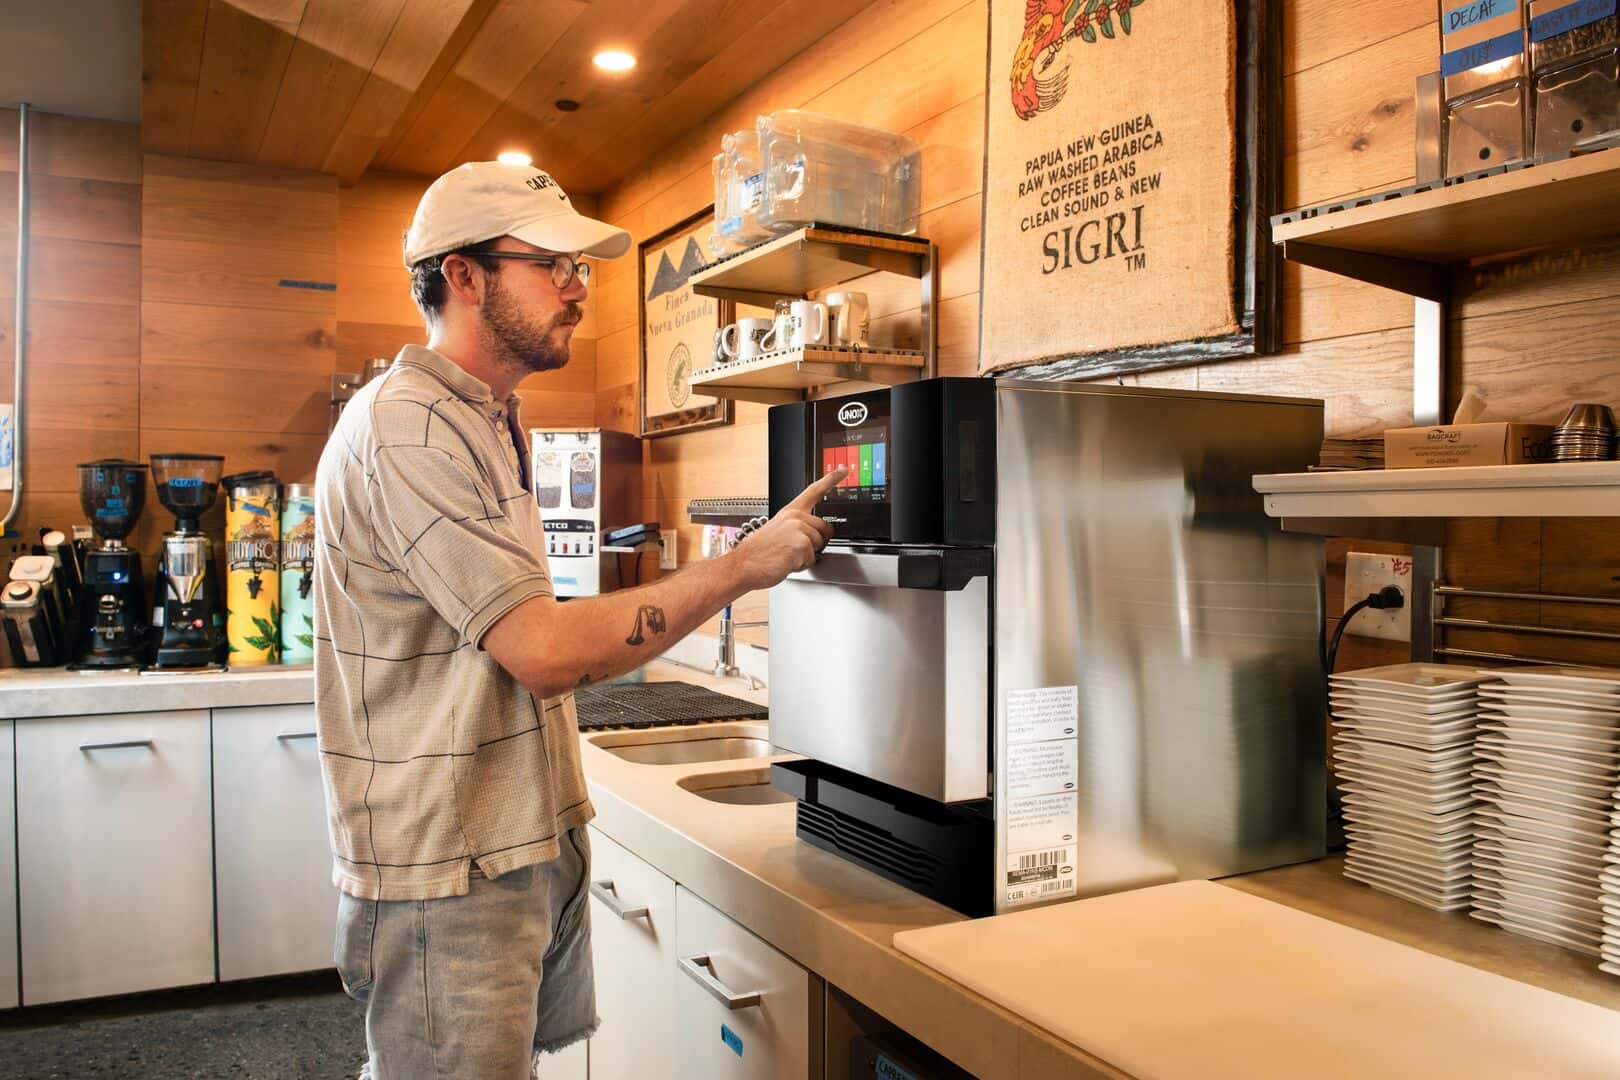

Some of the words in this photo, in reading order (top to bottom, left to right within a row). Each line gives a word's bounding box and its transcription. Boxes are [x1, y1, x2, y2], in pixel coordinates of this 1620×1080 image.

[1450, 0, 1496, 30] DECAF
[1018, 174, 1045, 198] RAW
[1048, 153, 1099, 185] WASHED
[1103, 131, 1163, 167] ARABICA
[1026, 148, 1063, 176] PAPUA
[1067, 134, 1096, 160] NEW
[1100, 113, 1154, 146] GUINEA
[1020, 206, 1060, 232] CLEAN
[1064, 190, 1110, 218] SOUND
[1114, 185, 1125, 201] &
[1130, 173, 1161, 196] NEW
[1040, 177, 1089, 207] COFFEE
[1094, 160, 1137, 192] BEANS
[1041, 204, 1145, 275] SIGRI
[1124, 252, 1146, 273] TM
